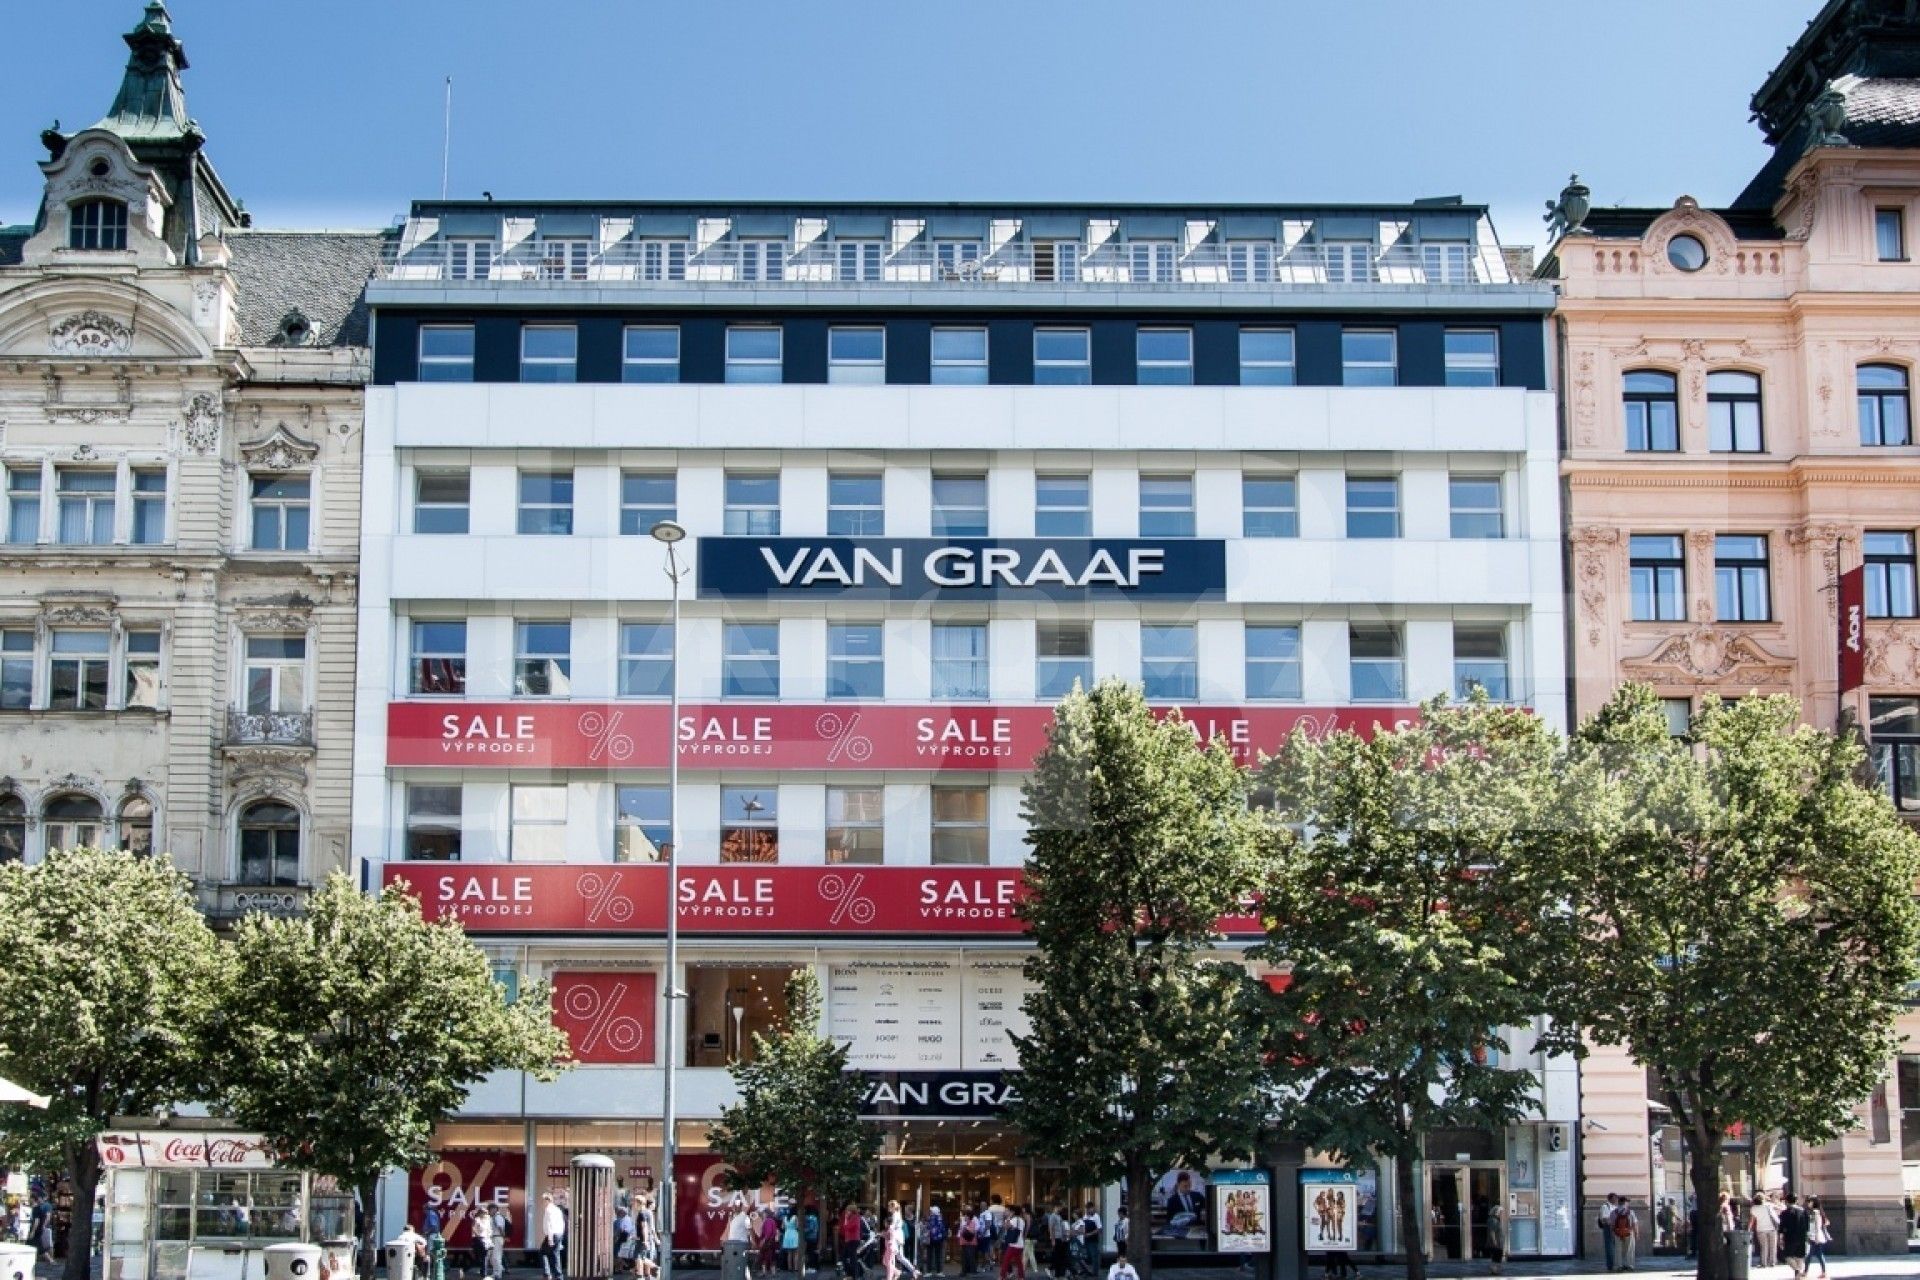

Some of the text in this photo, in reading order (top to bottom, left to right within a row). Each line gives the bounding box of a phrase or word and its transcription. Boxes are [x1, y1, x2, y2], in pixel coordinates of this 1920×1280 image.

[759, 546, 1165, 588] VAN GRAAF
[442, 714, 535, 739] SALE
[678, 716, 773, 741] SALE
[915, 718, 1012, 742] SALE
[442, 741, 535, 753] VÝPRODEJ
[677, 743, 773, 755] VÝPRODEJ
[915, 744, 1012, 756] VÝPRODEJ
[438, 876, 533, 901] SALE
[678, 878, 774, 902] SALE
[920, 880, 1016, 904] SALE
[678, 905, 775, 917] VÝPRODEJ
[427, 1186, 510, 1206] SALE
